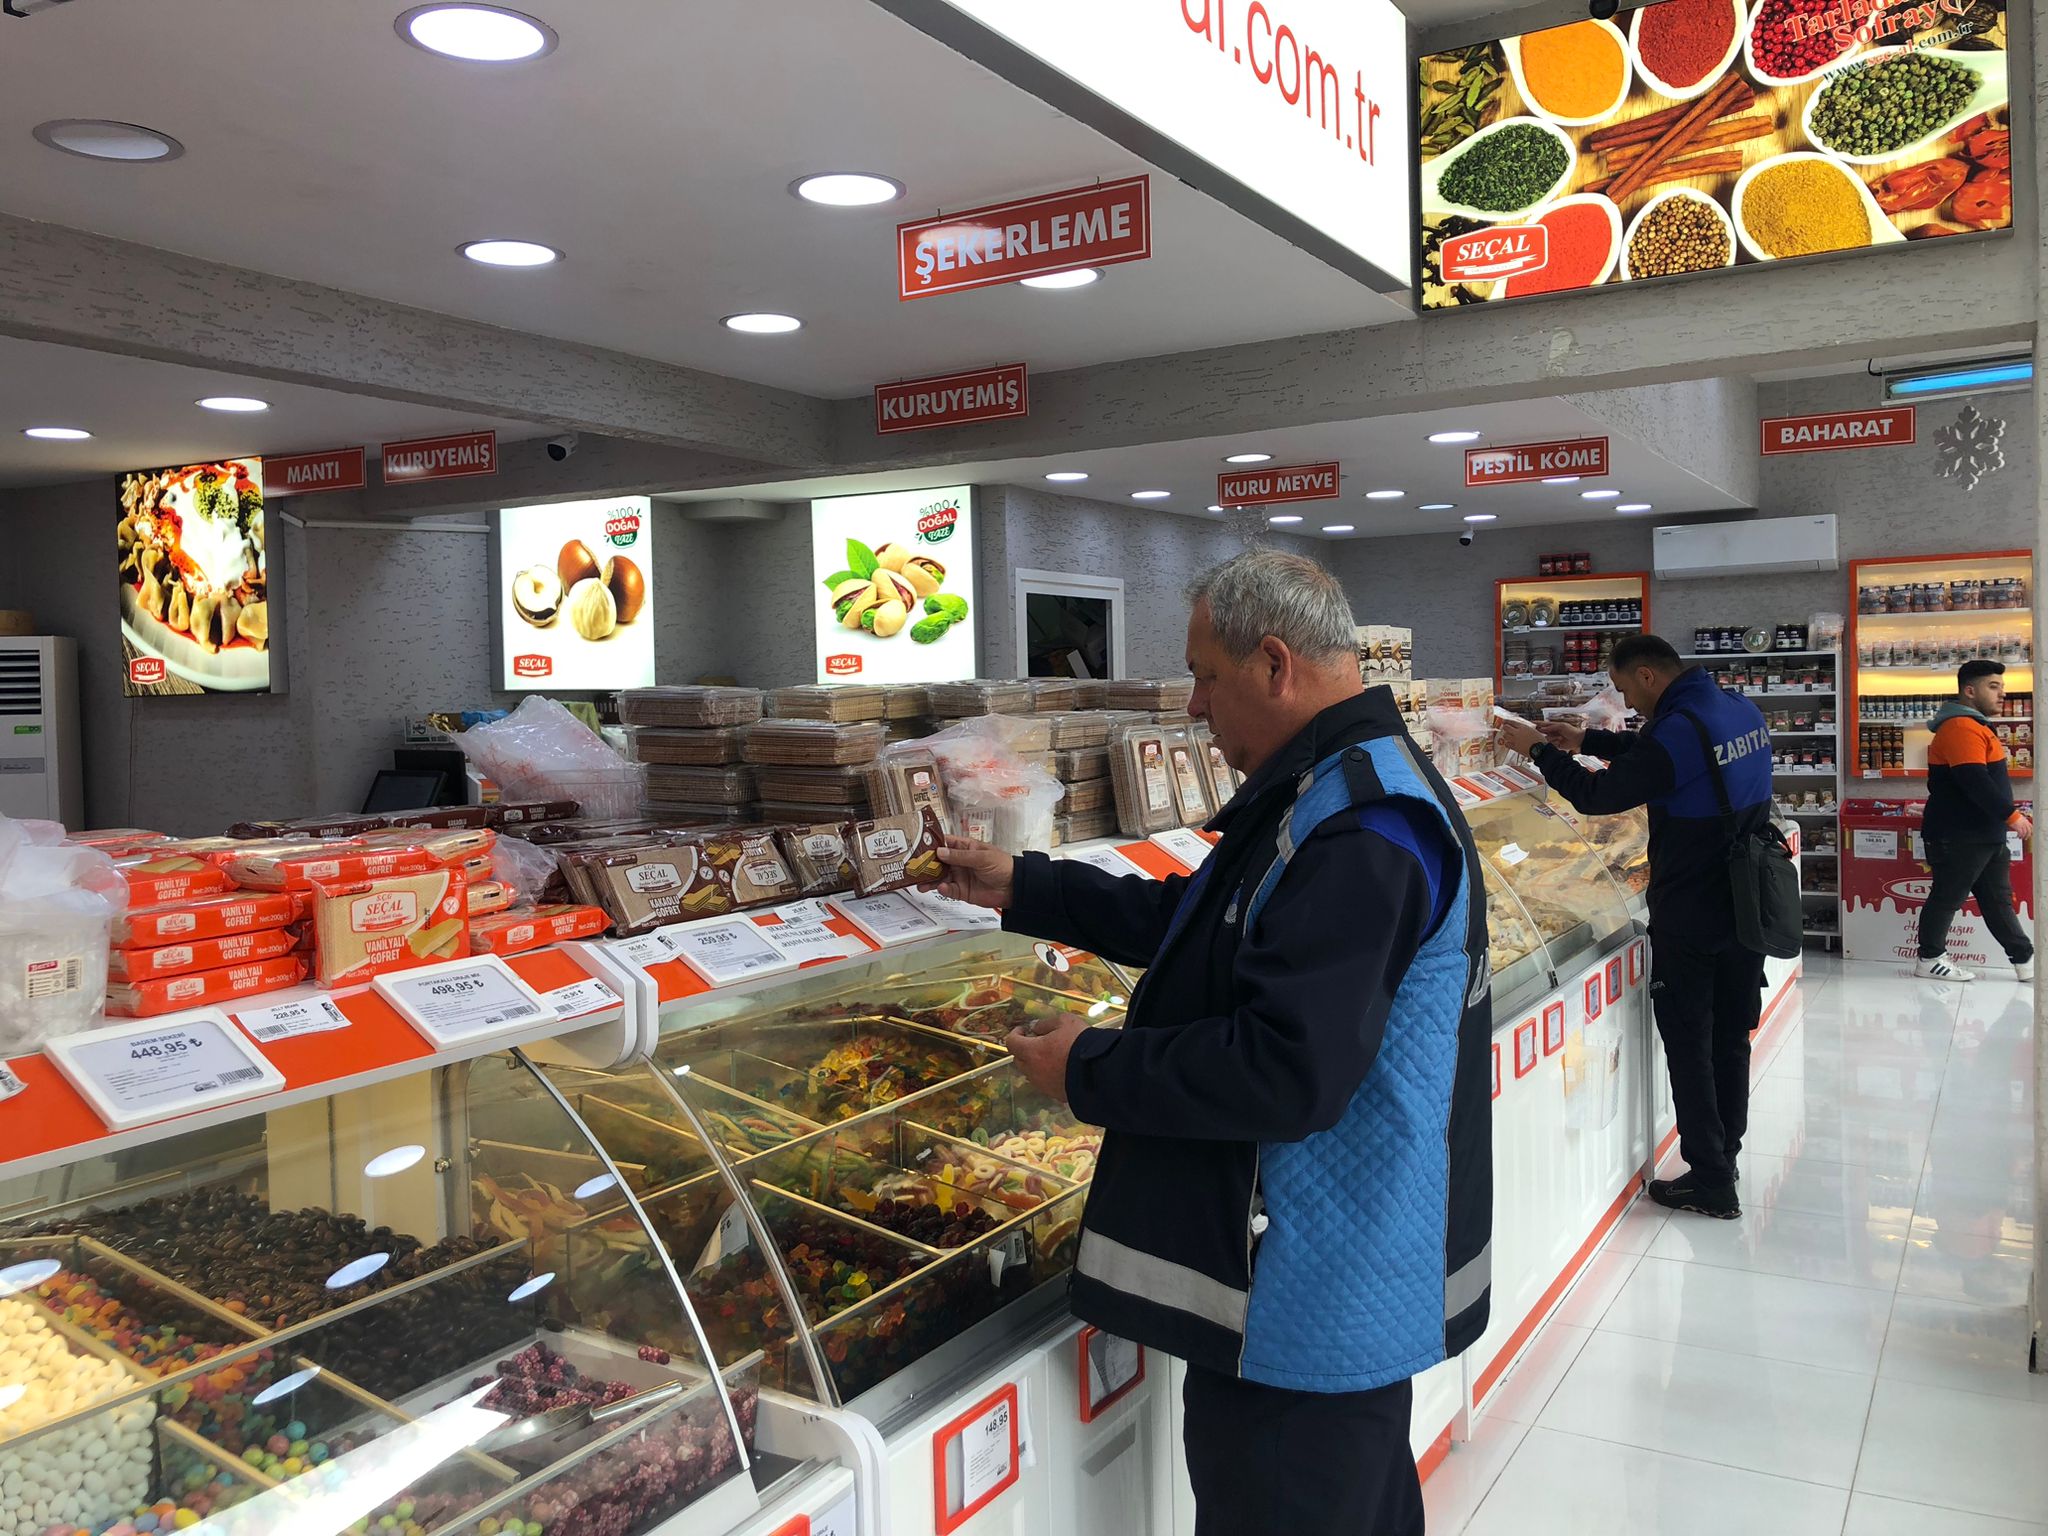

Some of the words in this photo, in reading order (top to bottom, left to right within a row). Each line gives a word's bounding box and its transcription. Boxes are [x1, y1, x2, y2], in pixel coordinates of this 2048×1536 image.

[915, 202, 1131, 285] ŞEKERLEME
[1456, 234, 1531, 261] SEÇAL
[883, 375, 1019, 421] KURUYEMİŞ
[1781, 418, 1893, 444] BAHARAT
[387, 439, 491, 473] KURUYEMİŞ
[1472, 451, 1534, 475] PESTİL
[1541, 445, 1601, 470] KÖME
[287, 461, 340, 484] MANTI
[1224, 478, 1271, 498] KURU
[1276, 472, 1333, 494] MEYVE
[606, 519, 638, 533] DOĞAL
[920, 513, 956, 530] DOĞAL
[135, 660, 160, 675] SEÇAL
[519, 658, 547, 669] SEÇAL
[830, 658, 857, 668] SEÇAL
[1713, 727, 1771, 766] ZABITA
[812, 840, 832, 850] SEÇAL
[874, 835, 898, 848] SEÇAL
[367, 865, 394, 875] GOFRET
[880, 860, 905, 874] KAKAOLU
[638, 869, 668, 880] SEÇAL
[884, 871, 905, 883] GOFRET
[154, 877, 190, 891] VANİLYALI
[157, 888, 186, 900] GOFRET
[366, 900, 403, 915] SEÇAL
[649, 895, 680, 908] KAKAOLU
[221, 904, 257, 918] VANİLYALI
[655, 905, 681, 917] GOFRET
[225, 915, 252, 927] GOFRET
[555, 924, 574, 935] GOFRET
[218, 936, 254, 950] VANİLYALI
[365, 934, 405, 954] VANİLYALI
[698, 933, 727, 945] 259,95
[222, 947, 250, 959] GOFRET
[370, 949, 400, 964] GOFRET
[228, 966, 262, 980] VANİLYALI
[232, 977, 259, 990] GOFRET
[432, 981, 473, 995] 498,95
[473, 979, 484, 988] ₺
[273, 1010, 300, 1020] 228,95
[130, 1037, 158, 1047] BADEM
[131, 1040, 187, 1059] 448,95
[188, 1038, 203, 1047] ₺
[985, 1411, 1008, 1437] 148,95
